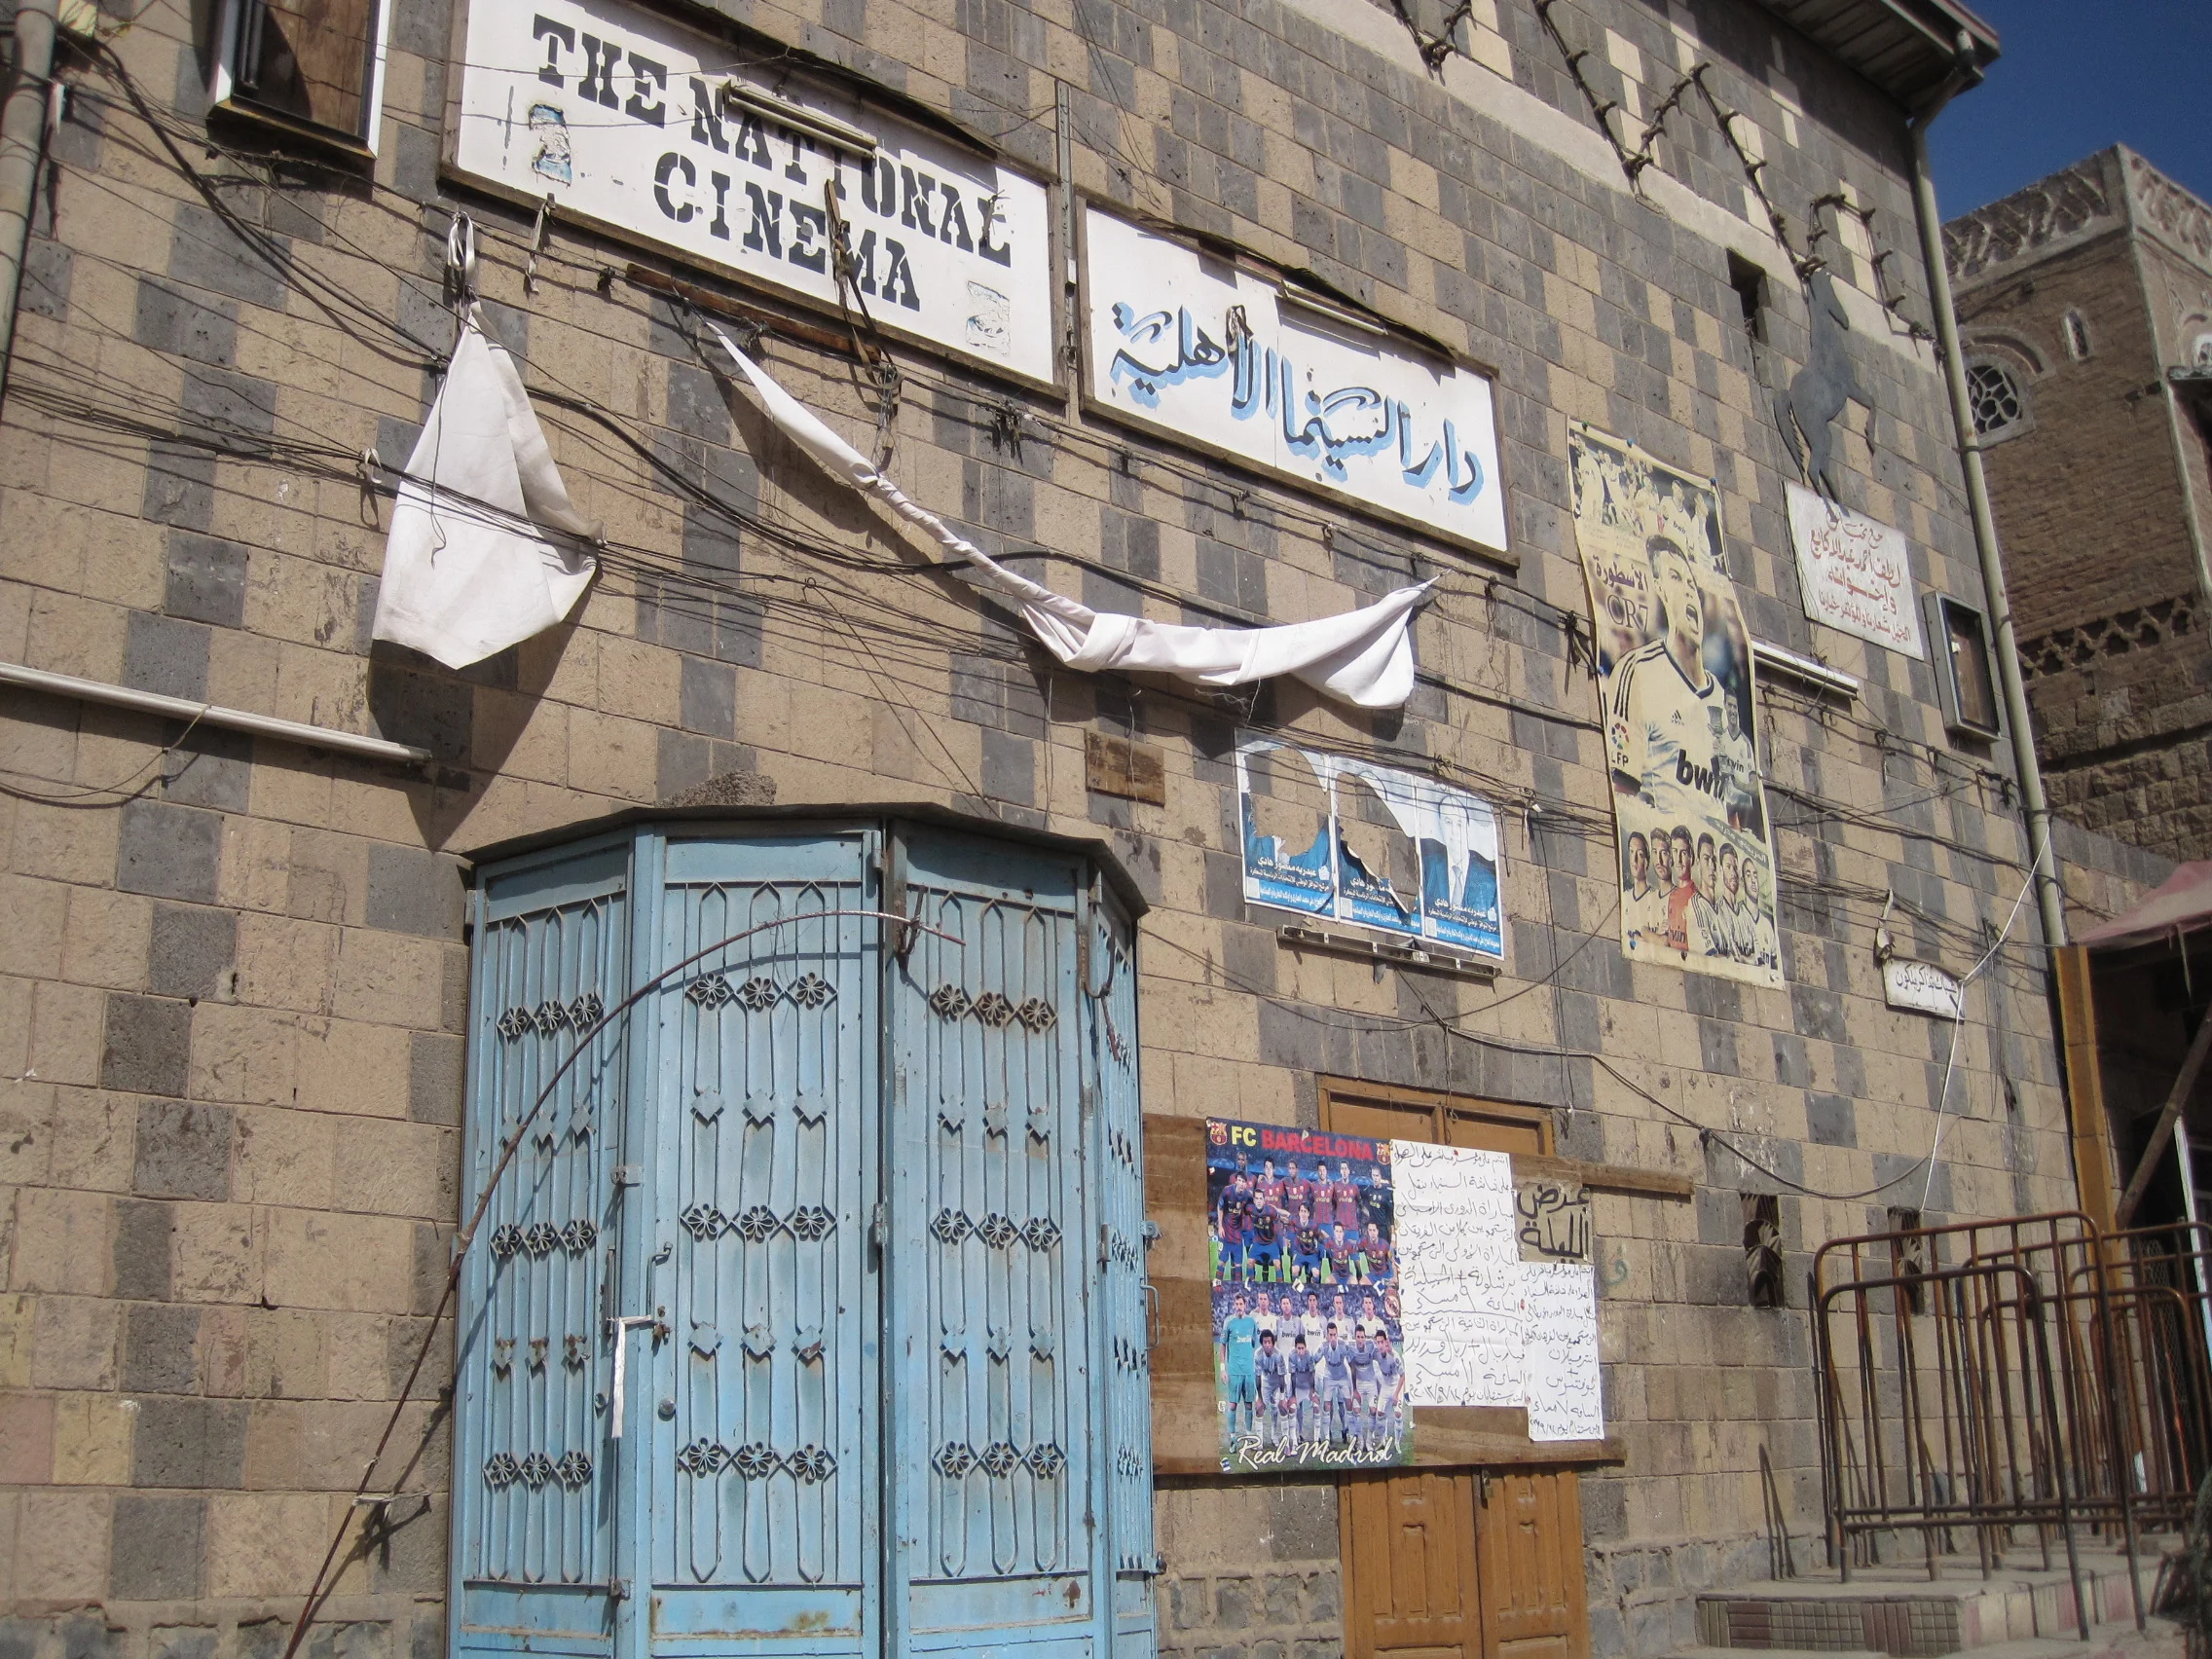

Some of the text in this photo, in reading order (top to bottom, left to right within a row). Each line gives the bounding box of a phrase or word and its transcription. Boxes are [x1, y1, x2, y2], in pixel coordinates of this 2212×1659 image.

[533, 13, 1012, 268] THE NATIONAL
[653, 151, 921, 312] CINEMA
[1281, 355, 1414, 483] السينما
[1402, 419, 1486, 506] دار
[1593, 554, 1649, 592] الأسطورة
[1606, 594, 1648, 633] CR7
[1231, 1125, 1374, 1161] FC BARCELONA
[1517, 1184, 1589, 1220] عرض
[1520, 1211, 1589, 1264] الليلة
[1236, 1435, 1394, 1471] Real Madrid
